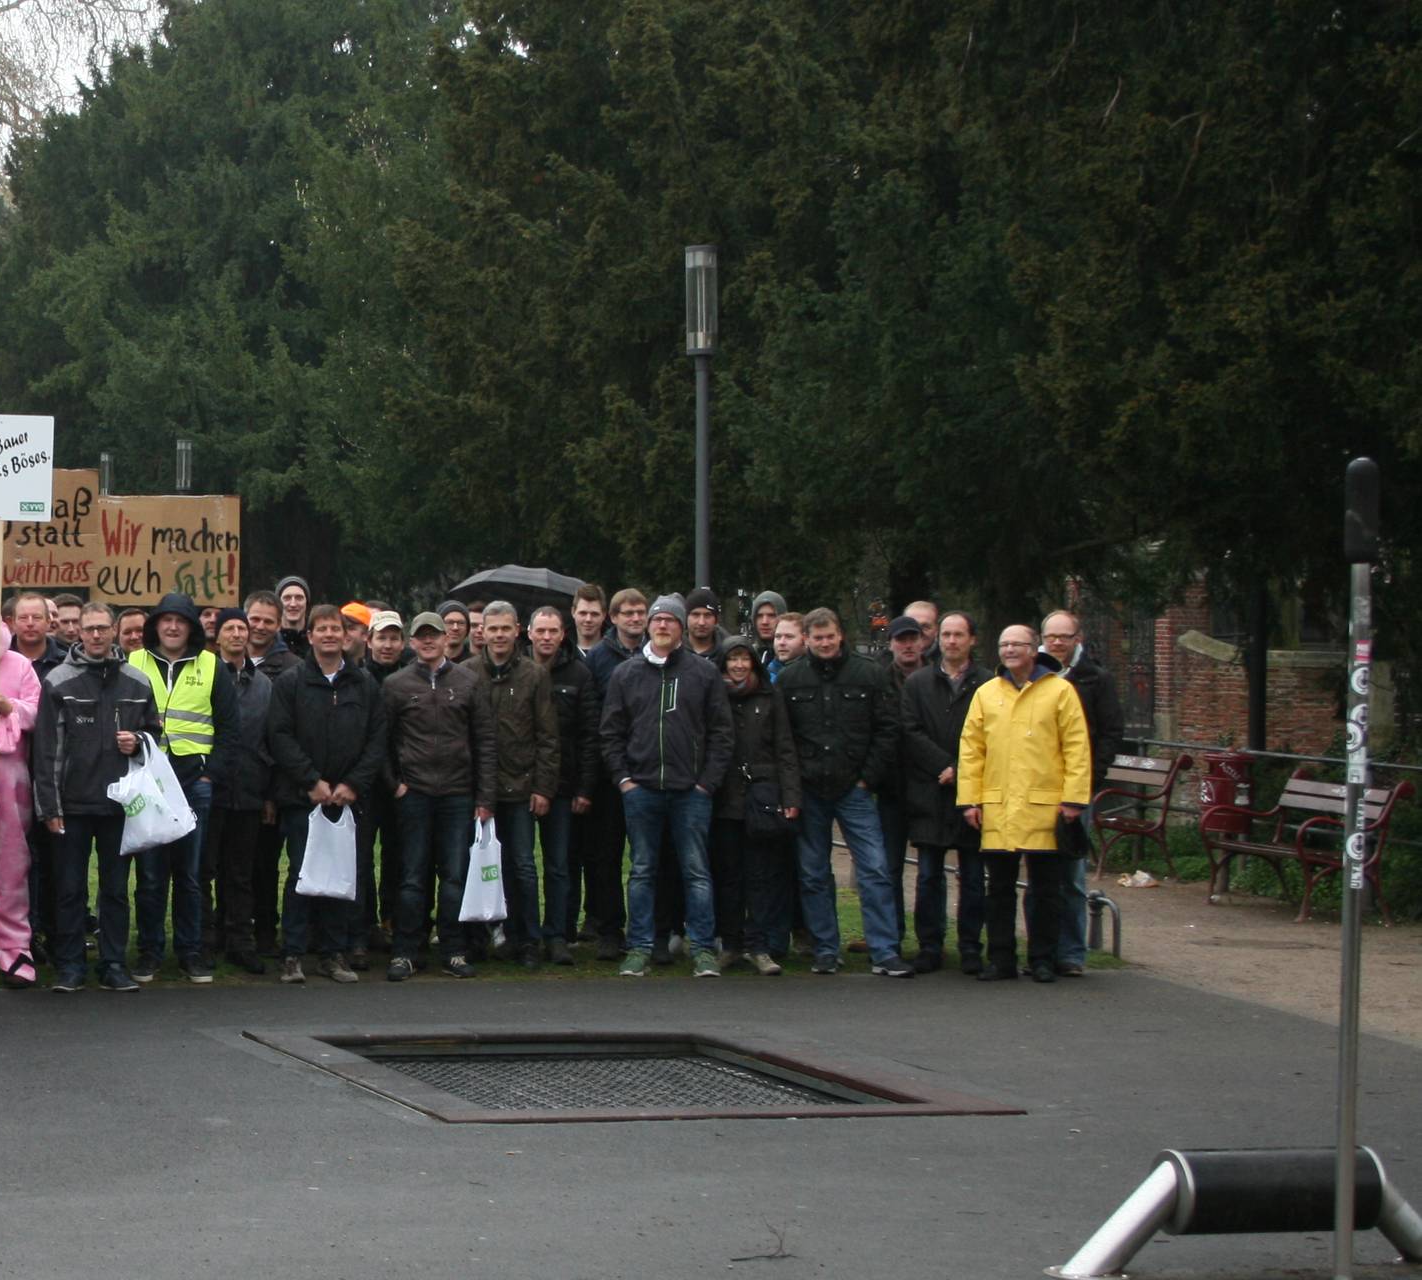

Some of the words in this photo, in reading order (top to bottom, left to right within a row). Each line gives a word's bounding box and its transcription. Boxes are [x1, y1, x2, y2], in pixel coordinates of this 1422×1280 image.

[11, 450, 51, 474] Böses.
[16, 518, 85, 548] statt
[101, 508, 144, 557] Wir
[151, 517, 239, 555] machen
[97, 559, 162, 596] euch
